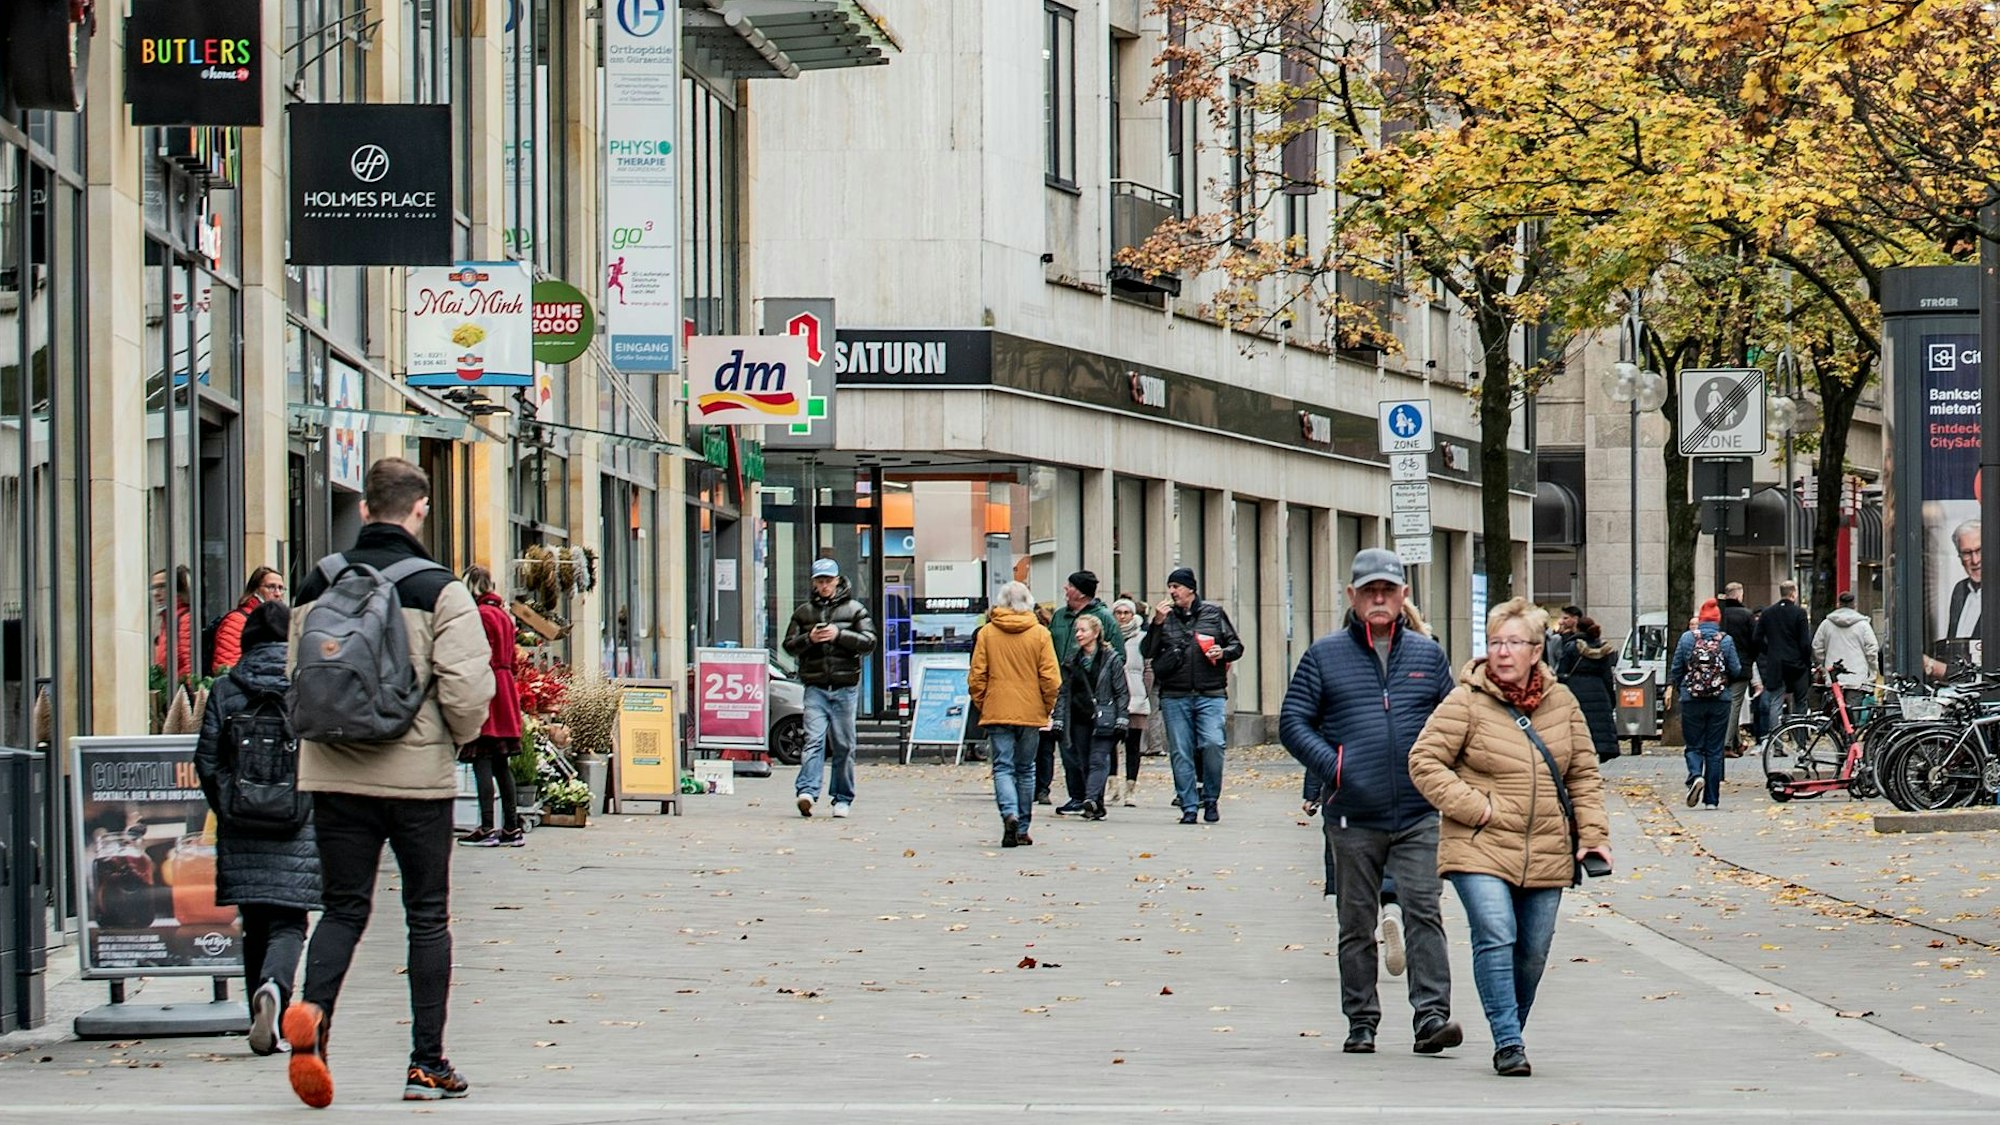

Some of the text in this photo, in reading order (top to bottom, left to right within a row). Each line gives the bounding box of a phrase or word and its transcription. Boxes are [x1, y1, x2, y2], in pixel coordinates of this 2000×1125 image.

[142, 38, 251, 64] BUTLERS
[617, 158, 666, 166] THERAPIE
[304, 191, 436, 207] HOLMES PLACE
[414, 288, 523, 316] Mai Minh
[1920, 298, 1958, 307] STRÖER
[532, 304, 583, 318] LUME
[615, 342, 669, 352] EINGANG
[835, 342, 946, 374] SATURN
[715, 350, 787, 391] dm
[1394, 440, 1420, 449] ZONE
[1701, 435, 1742, 449] ZONE
[926, 598, 969, 609] SAMSUNG
[705, 673, 764, 700] 25%
